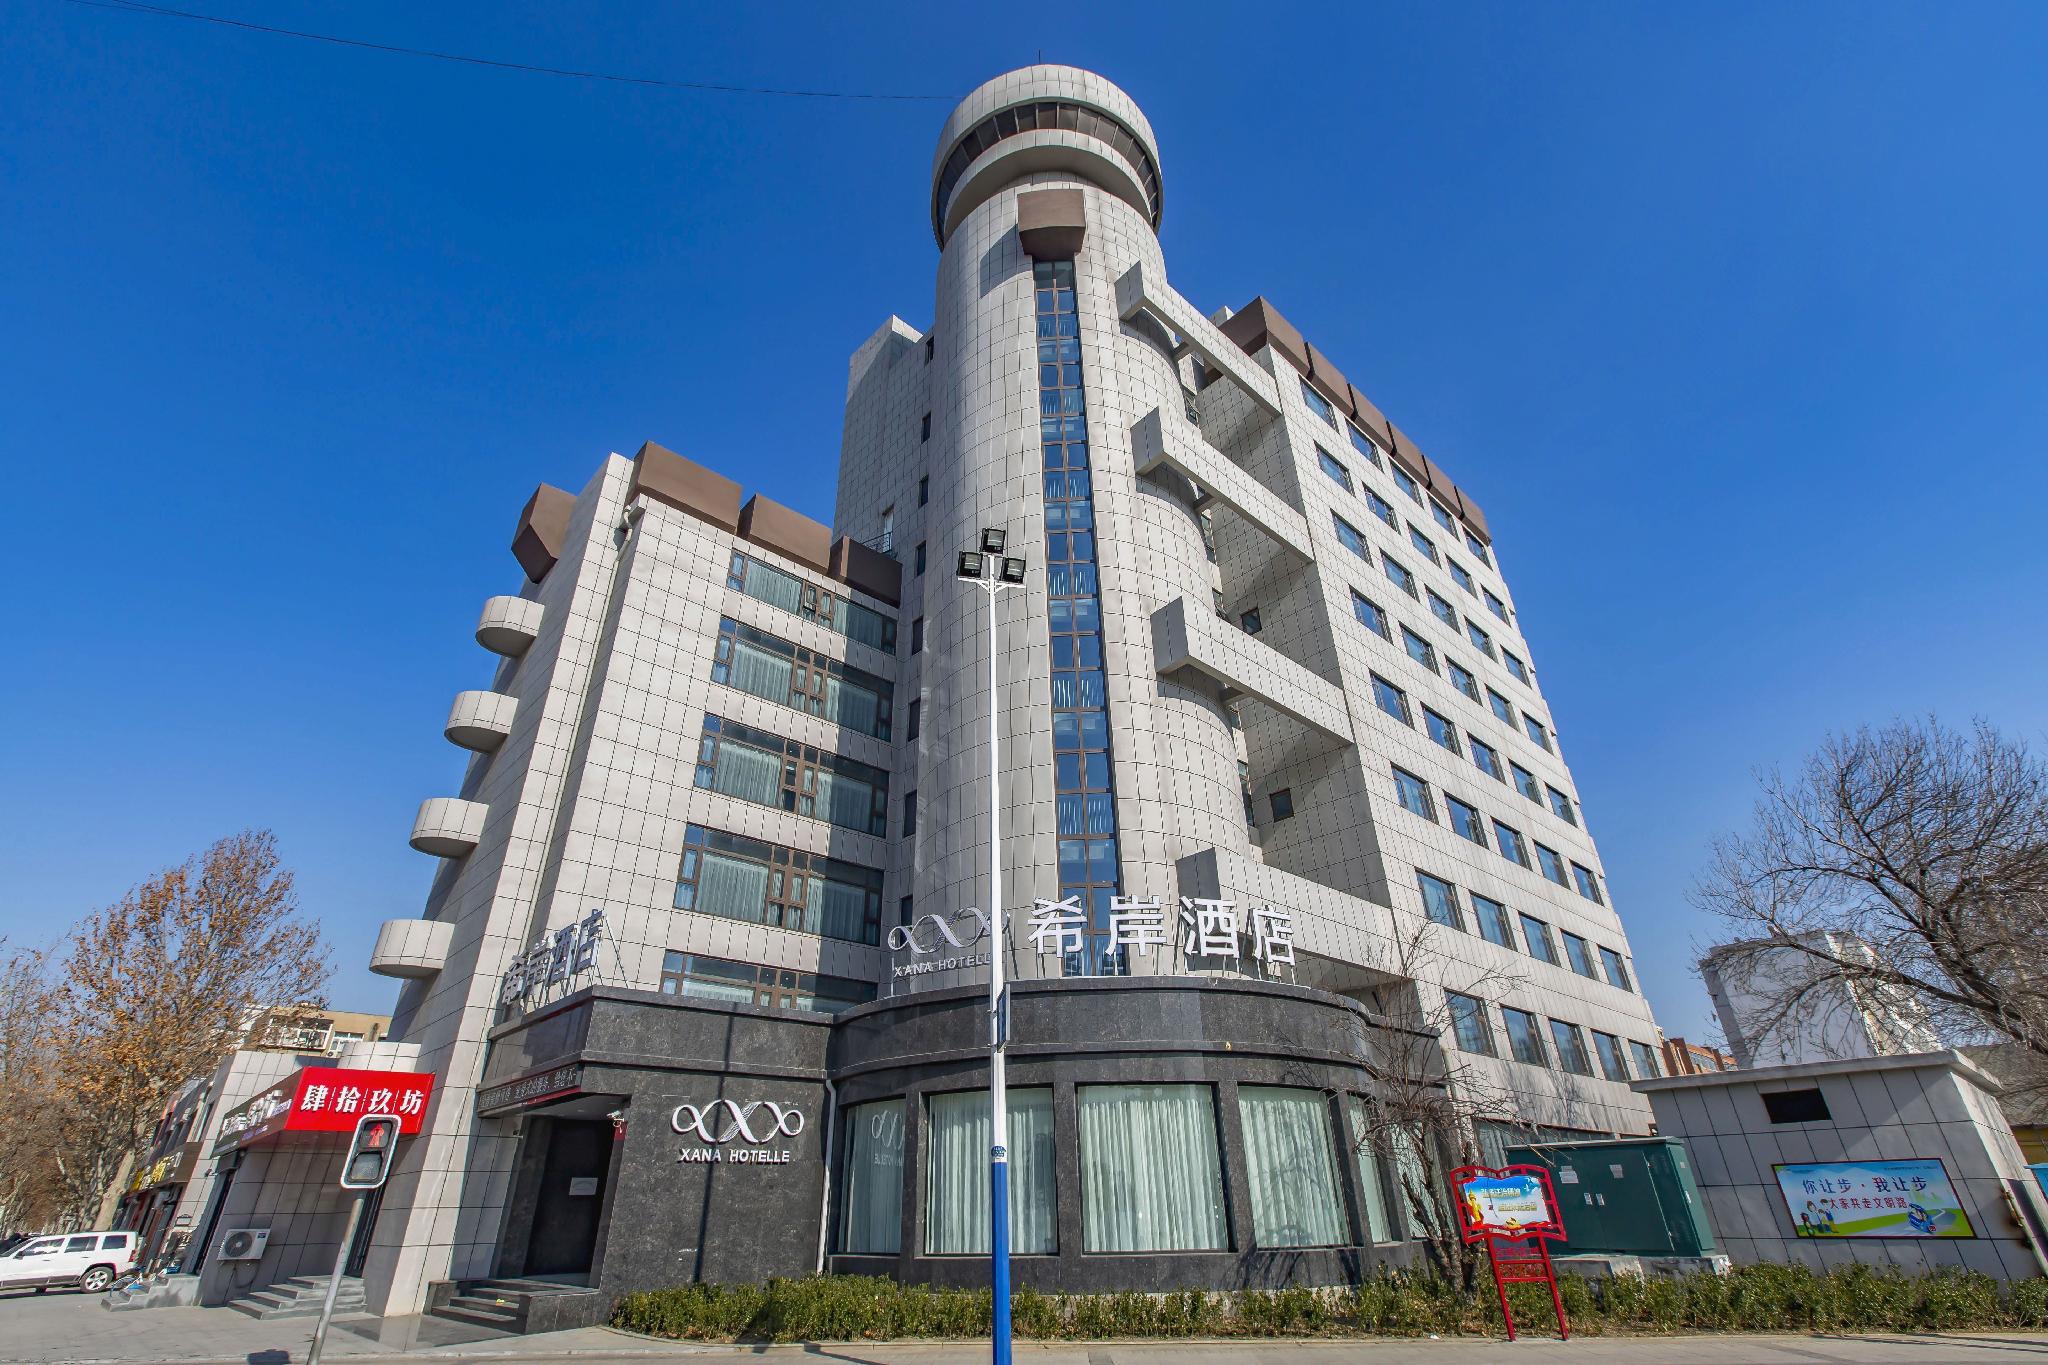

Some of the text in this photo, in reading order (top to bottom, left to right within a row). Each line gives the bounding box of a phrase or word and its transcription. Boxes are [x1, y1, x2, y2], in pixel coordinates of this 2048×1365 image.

[1027, 894, 1296, 966] 希岸酒店
[894, 952, 992, 978] XANA HOTELL
[300, 1084, 425, 1115] 肆拾玖坊
[679, 1148, 790, 1163] XANA HOTELLE
